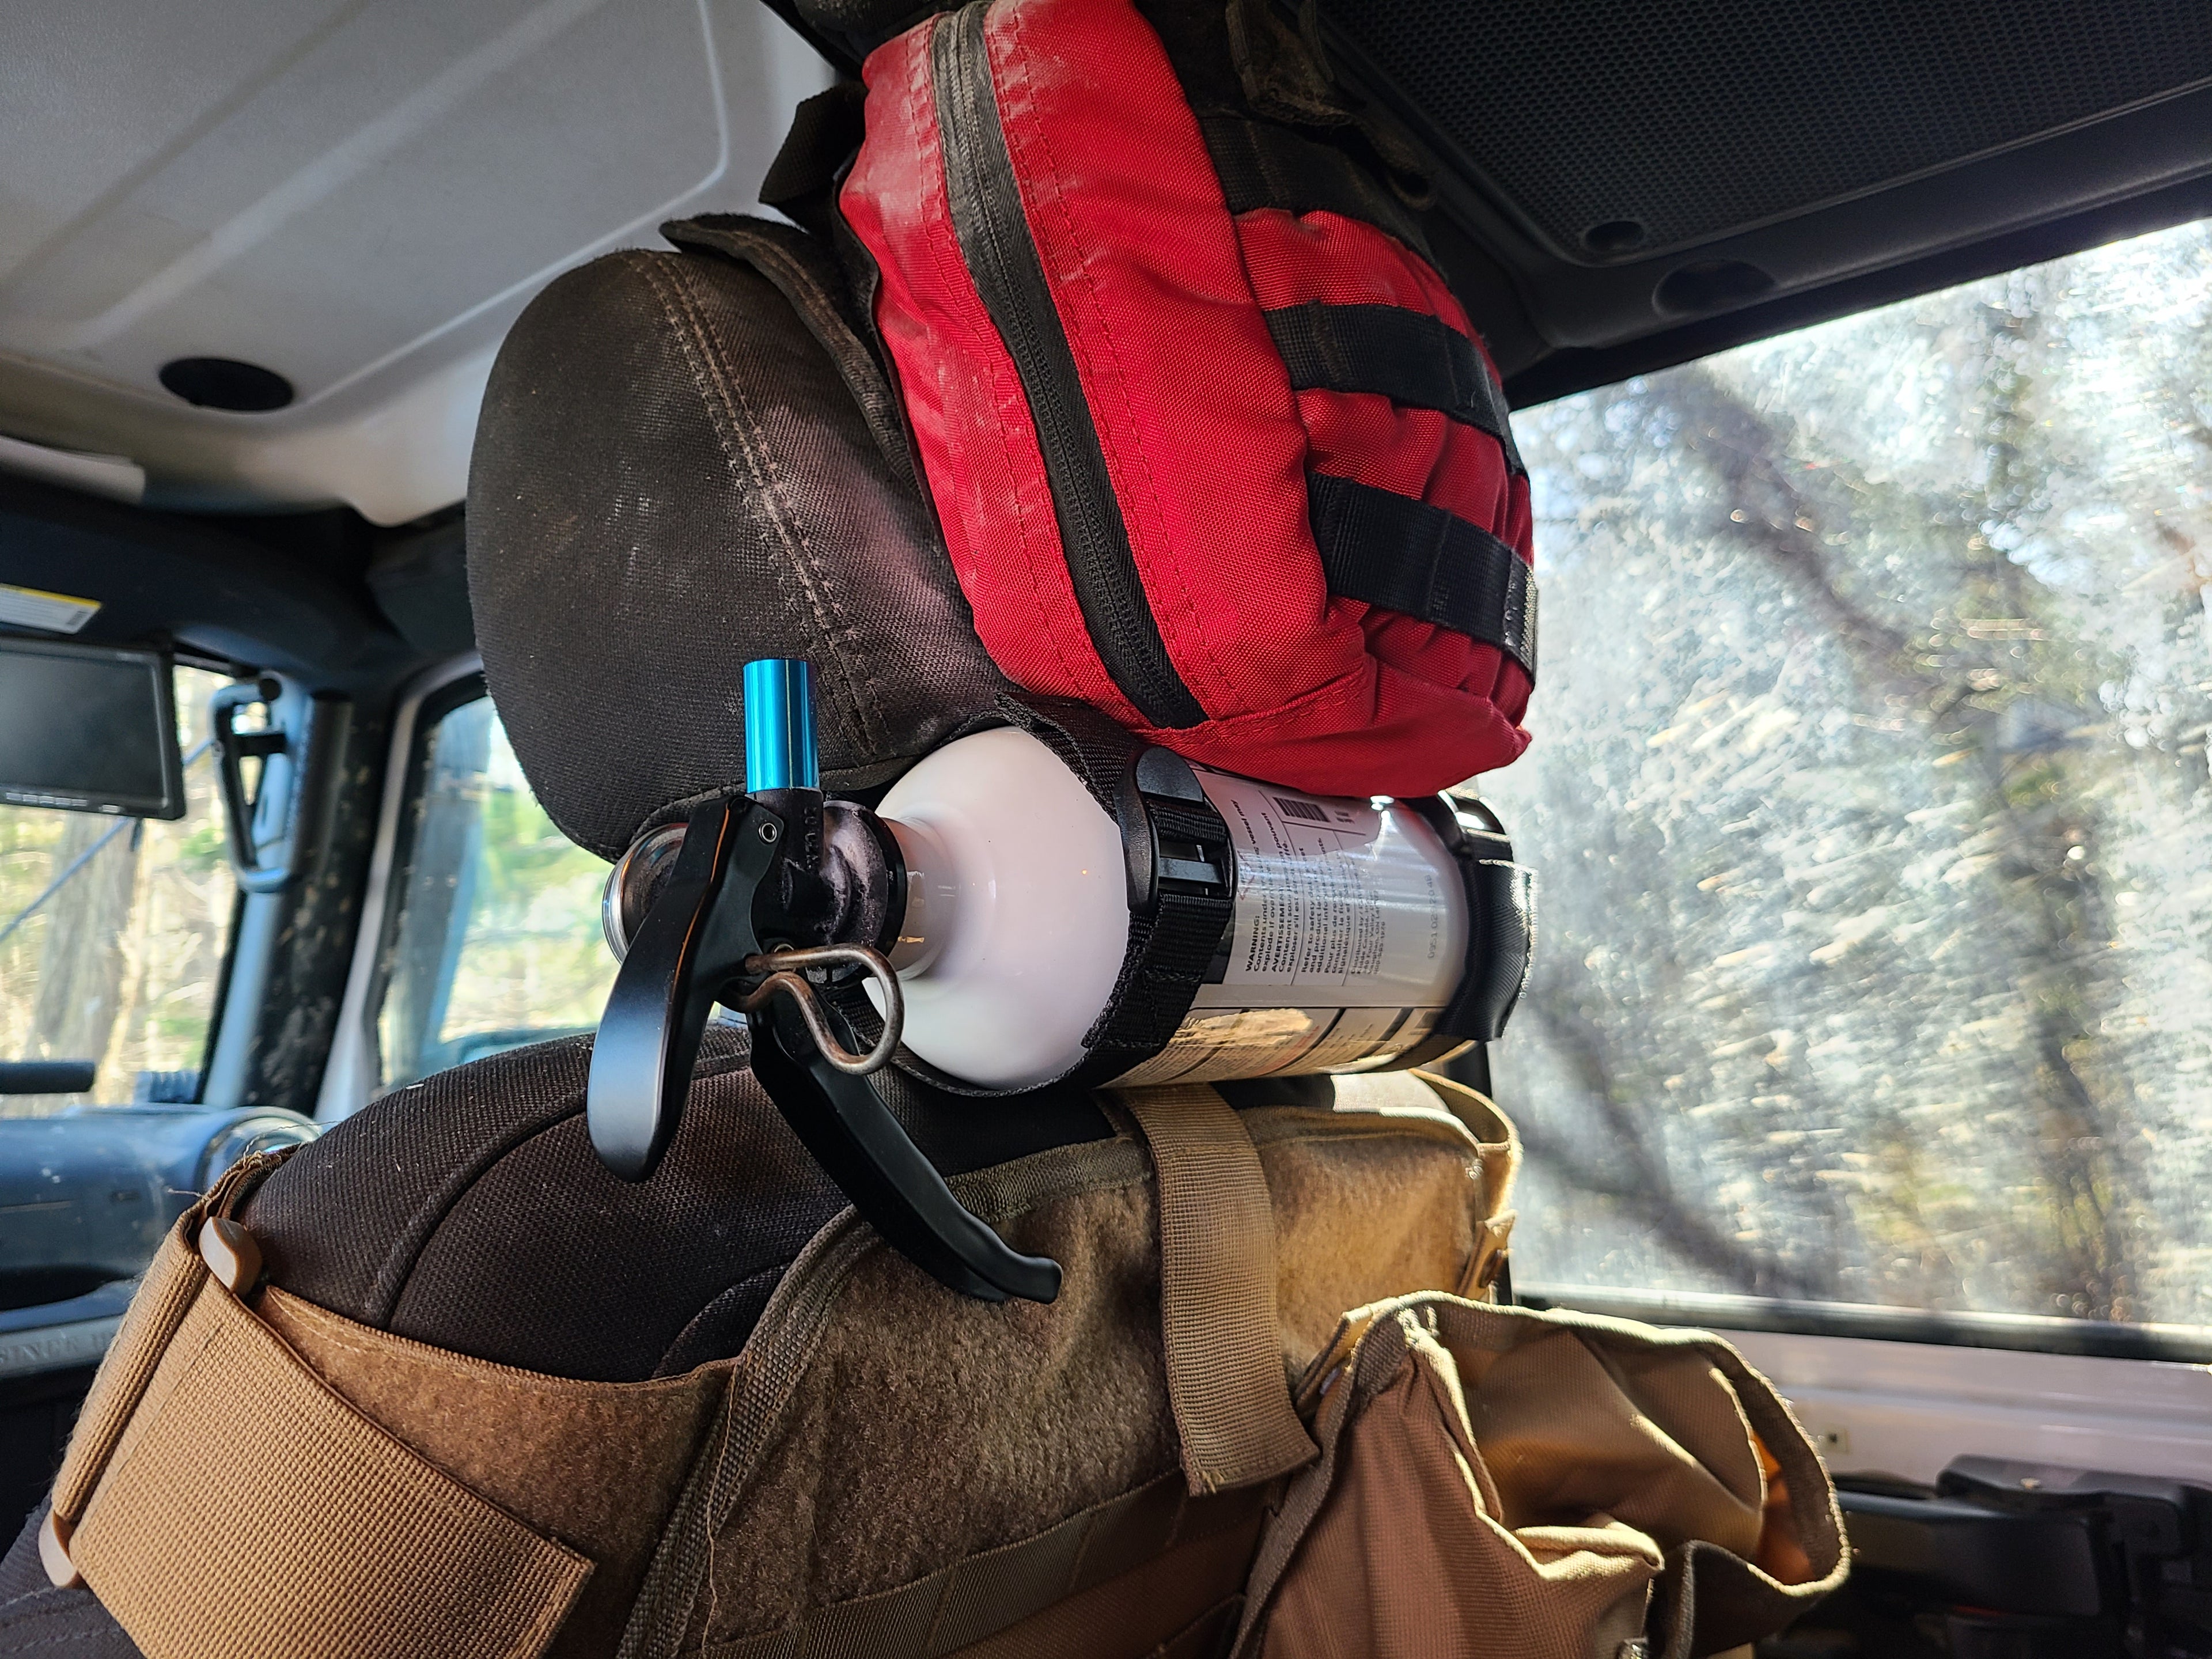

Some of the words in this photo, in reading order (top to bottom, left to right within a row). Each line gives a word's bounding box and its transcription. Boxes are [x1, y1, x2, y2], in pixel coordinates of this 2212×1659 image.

[1230, 800, 1244, 816] may
[1260, 812, 1283, 849] pouvant
[1241, 819, 1256, 844] vessel
[1245, 916, 1259, 972] WARNING:
[1253, 926, 1267, 972] Contents
[1262, 931, 1274, 972] explode
[1278, 919, 1291, 972] Contenant
[1286, 931, 1298, 972] exploser
[1301, 947, 1311, 972] Refer
[1308, 934, 1313, 944] to
[1309, 955, 1317, 973] and
[1313, 912, 1321, 952] product
[1316, 924, 1328, 973] additional
[1324, 952, 1334, 974] Pour
[1332, 915, 1337, 927] de
[1332, 929, 1344, 974] consulter
[1339, 917, 1344, 926] la
[1350, 929, 1363, 974] Distributed
